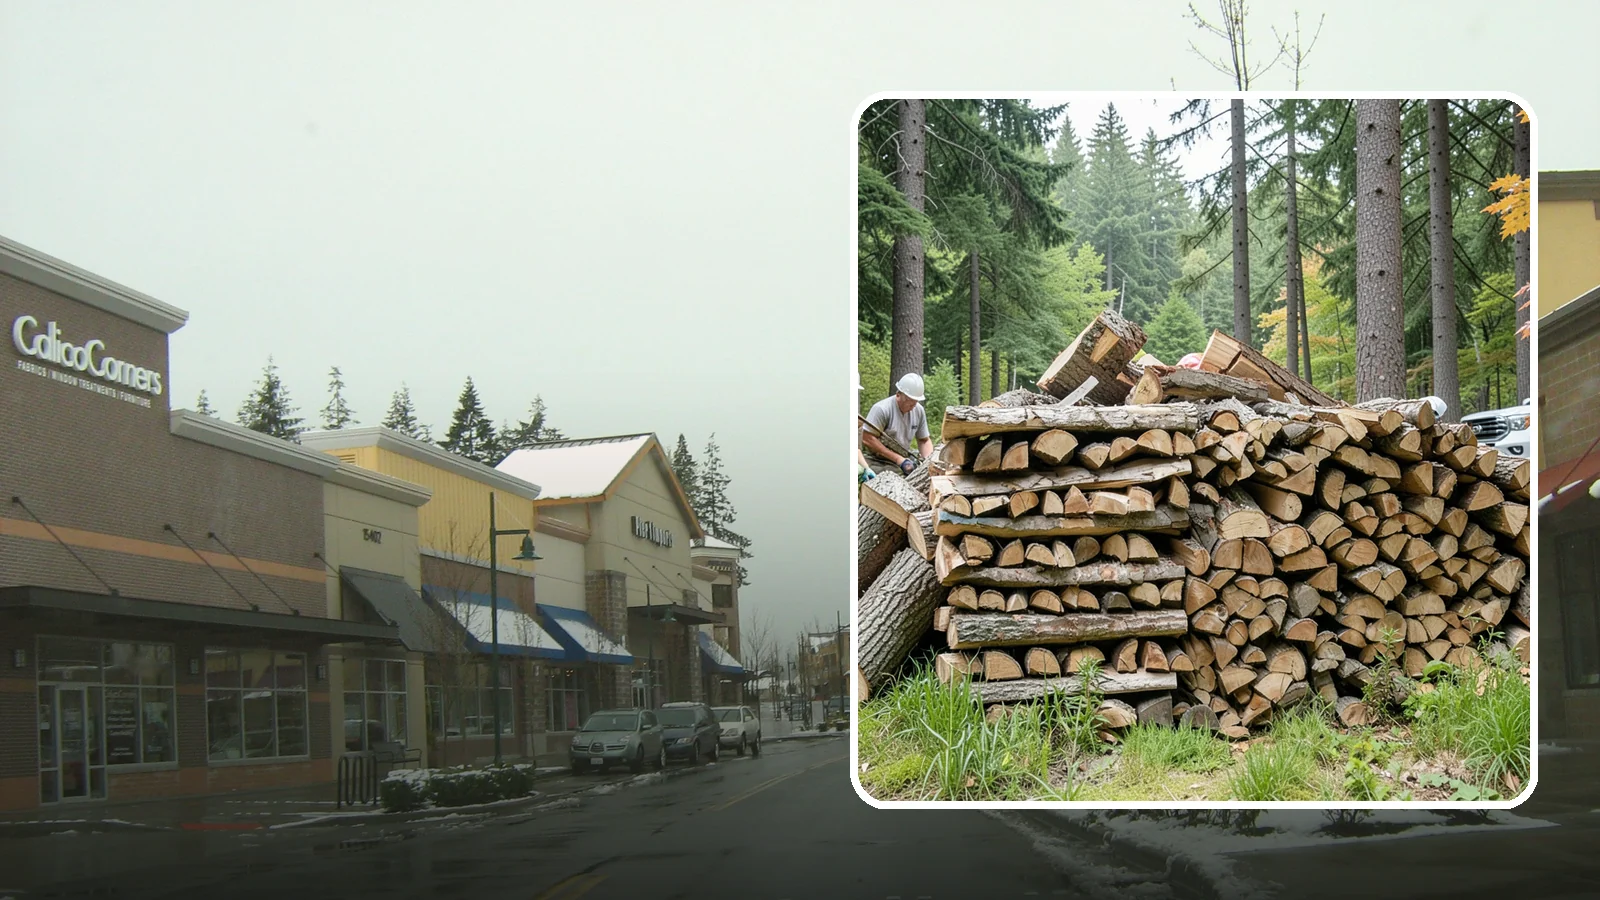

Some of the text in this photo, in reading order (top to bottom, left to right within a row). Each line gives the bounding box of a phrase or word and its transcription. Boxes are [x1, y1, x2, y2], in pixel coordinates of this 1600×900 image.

[17, 360, 47, 377] FABRICS
[51, 370, 78, 386] WINDOW
[79, 378, 116, 398] TREATMENTS
